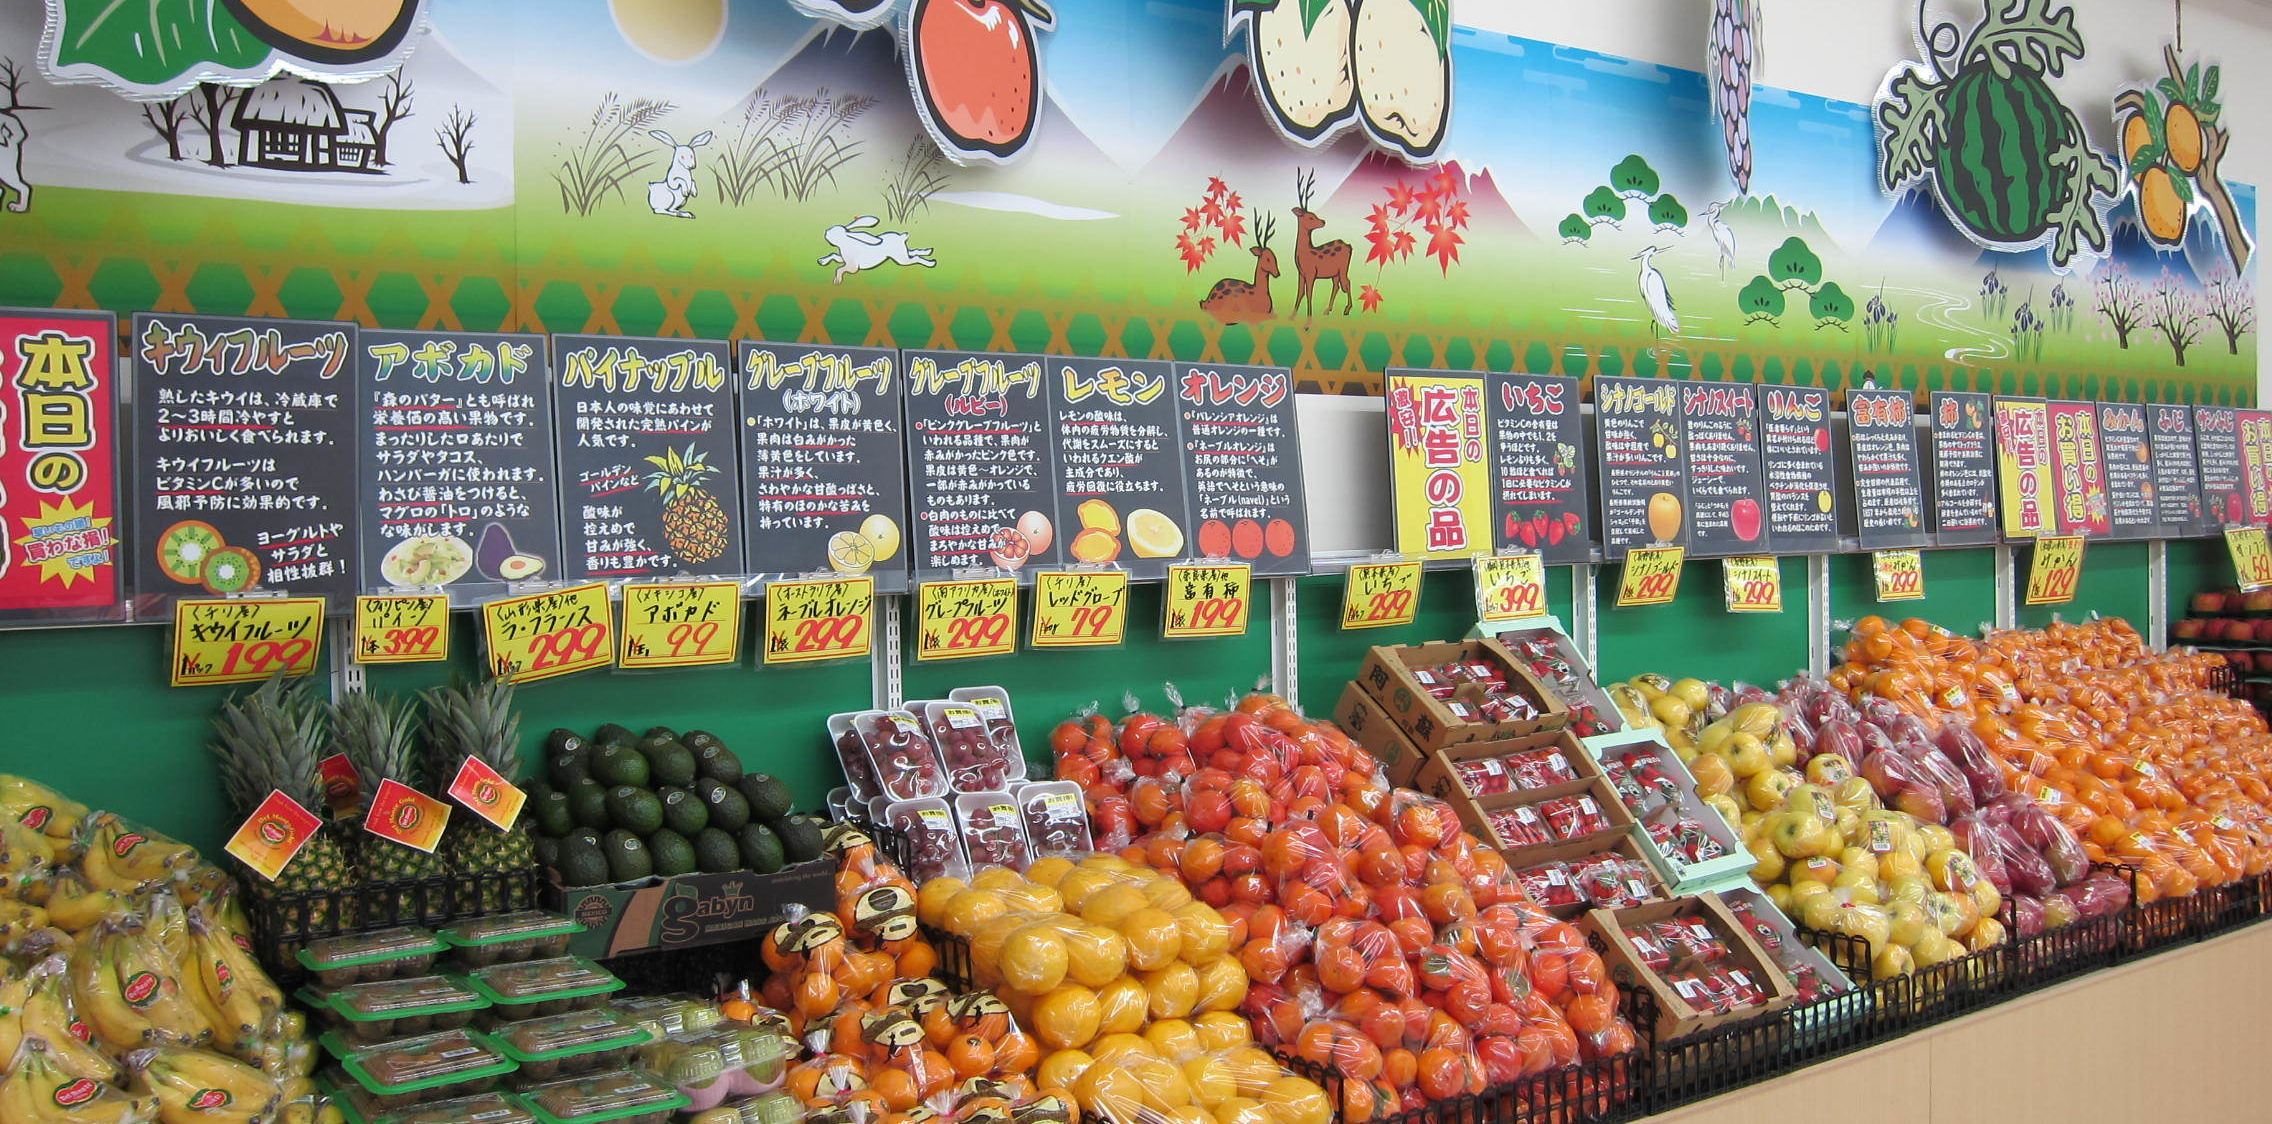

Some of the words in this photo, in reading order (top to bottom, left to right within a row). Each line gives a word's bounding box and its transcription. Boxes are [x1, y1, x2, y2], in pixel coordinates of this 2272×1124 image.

[368, 341, 533, 384] アボカド
[563, 347, 725, 393] パイナップル
[746, 349, 892, 395] グレープフルーツ
[910, 357, 1041, 398] グレープフルーツ
[1061, 366, 1164, 405] レモン
[1180, 369, 1287, 408] オレンジ
[576, 402, 713, 416] 日本人の味覚にあわせて
[1601, 383, 1676, 415] シナノゴールド
[1684, 386, 1754, 417] シナノスイート
[1852, 394, 1907, 427] 富有柿
[13, 331, 98, 494] 本日の
[576, 418, 711, 432] 開発された完熟パインが
[1461, 385, 1482, 462] 本日の
[157, 428, 335, 446] よりおいしく食べられます。
[375, 433, 523, 446] まったりした口あたりで
[578, 435, 636, 447] 人気です。
[2075, 411, 2097, 483] 本日の
[156, 457, 276, 471] キウイフルーツは
[579, 465, 632, 481] ゴールデン
[1420, 384, 1467, 551] 広告の品
[2014, 409, 2042, 530] 広告の品
[2056, 412, 2086, 522] お買い得
[156, 477, 299, 490] ビタミンCが多いので
[591, 477, 639, 492] パインなど
[156, 495, 328, 511] 風邪予防に効果的です。
[583, 506, 622, 519] 酸味が
[257, 523, 343, 546] ヨーグルトや
[381, 523, 474, 538] な味がします。
[584, 523, 635, 535] 控えめで
[271, 546, 328, 563] サラダと
[1365, 573, 1411, 595] いちご
[1490, 570, 1531, 586] いちご
[1637, 574, 1674, 598] 299
[1891, 571, 1918, 592] 299
[1049, 586, 1125, 607] レッドグローブ
[1368, 590, 1411, 620] 299
[1500, 583, 1539, 612] 399
[1744, 581, 1774, 604] 299
[373, 612, 427, 628] パイン
[644, 601, 720, 623] アボカド
[777, 595, 872, 621] ネーブルオレンジ
[926, 598, 1007, 619] グレープフルーツ
[1071, 605, 1112, 636] 79
[1190, 598, 1242, 628] 199
[191, 617, 311, 642] キウイフルーツ
[383, 627, 439, 654] 399
[667, 622, 719, 657] 99
[795, 615, 862, 652] 299
[948, 614, 1009, 648] 299
[221, 639, 313, 675] 199
[528, 623, 606, 670] 299
[661, 894, 754, 944] gabyn
